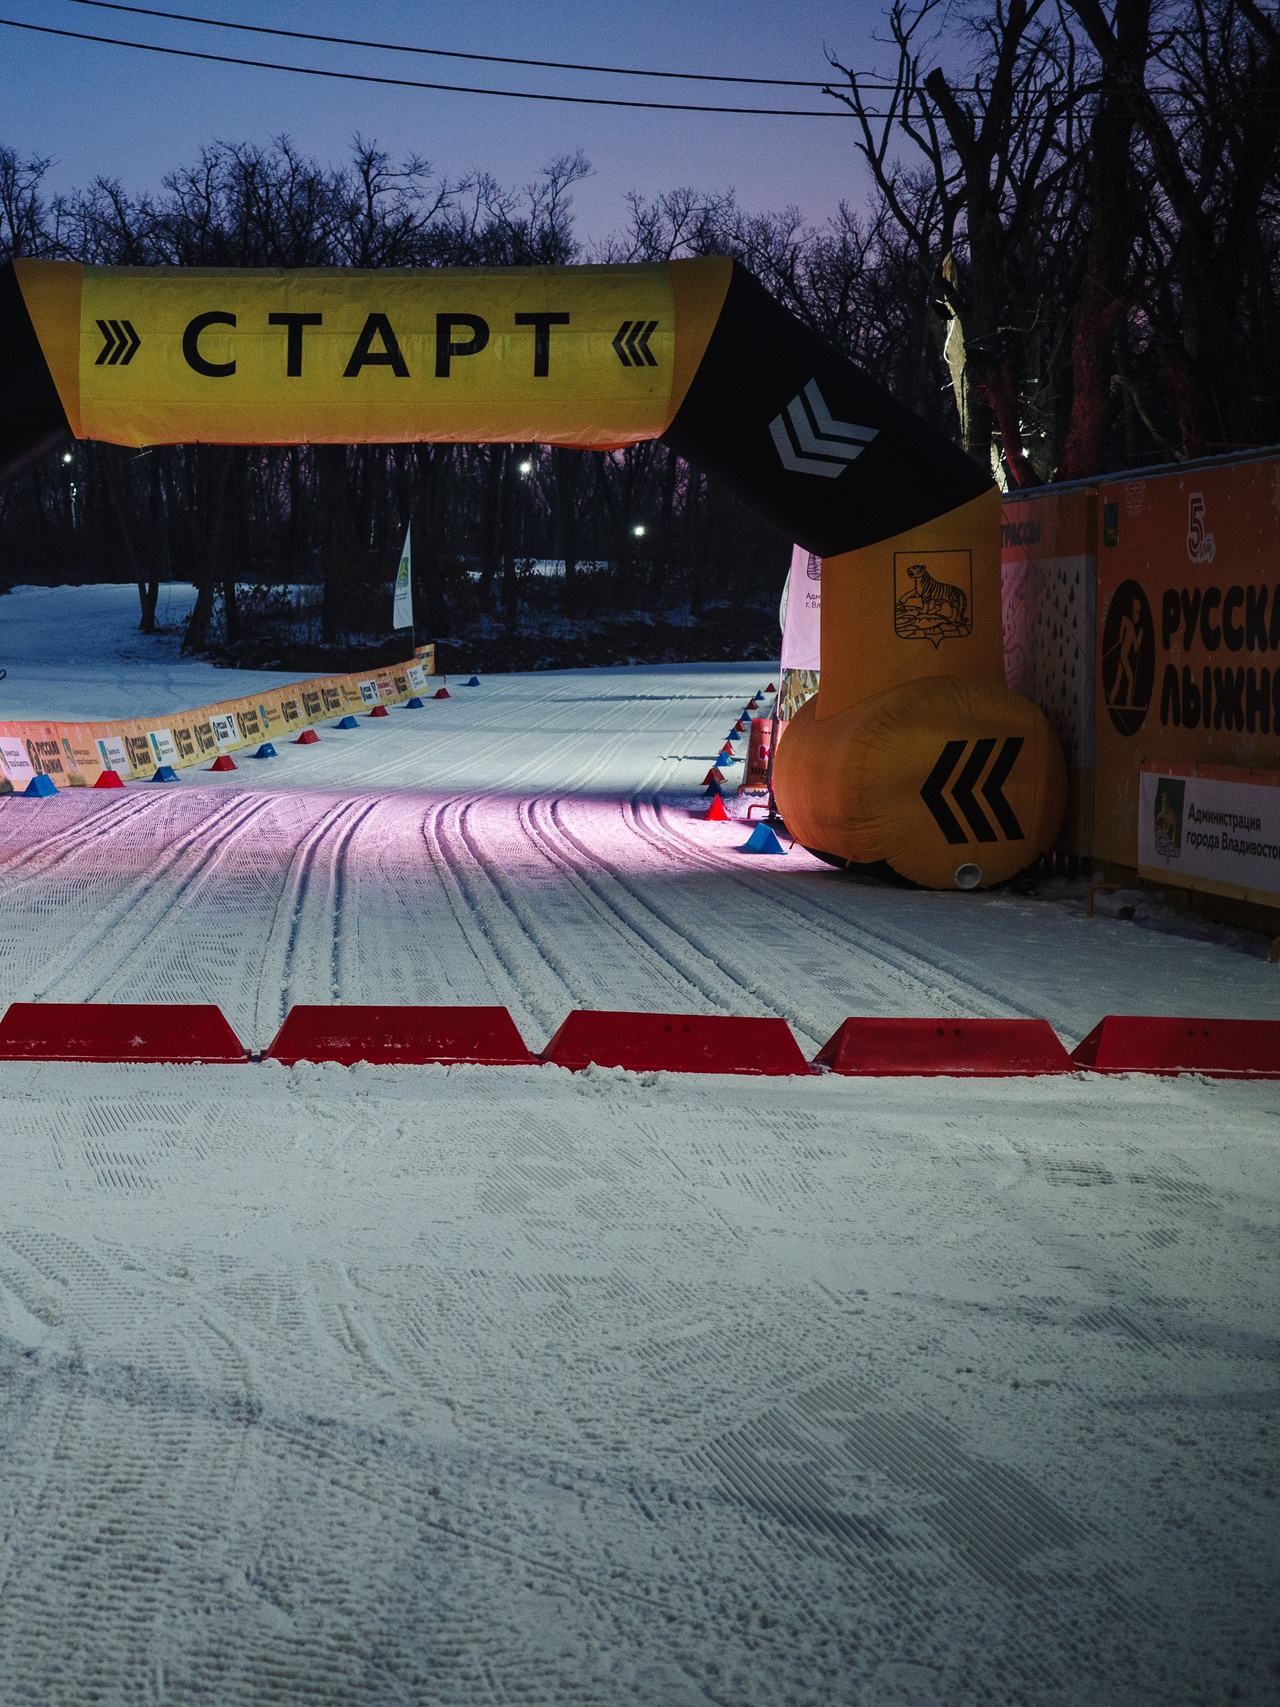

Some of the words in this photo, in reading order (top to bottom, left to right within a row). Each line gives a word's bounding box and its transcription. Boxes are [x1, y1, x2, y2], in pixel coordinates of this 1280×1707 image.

[181, 310, 571, 378] СТАРТ
[1187, 803, 1261, 833] Администрация
[1186, 830, 1220, 850] города
[1221, 832, 1280, 860] Владивосто
